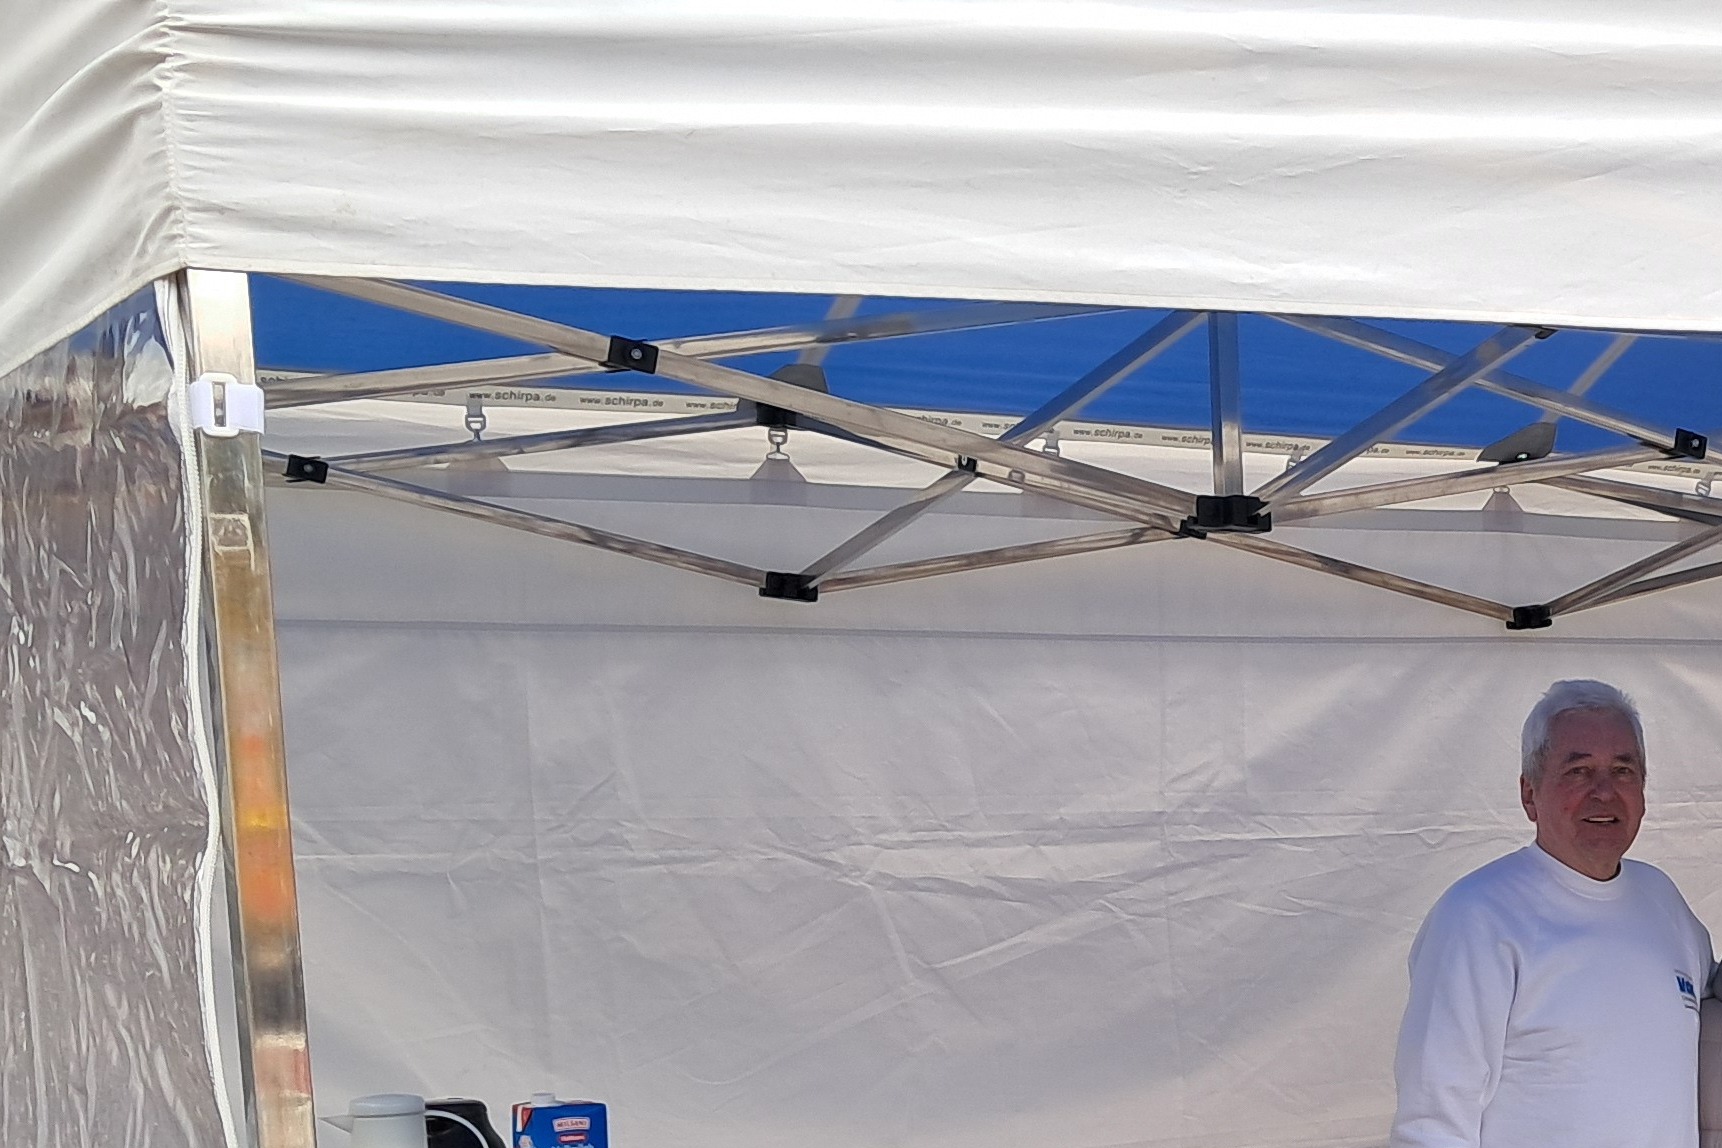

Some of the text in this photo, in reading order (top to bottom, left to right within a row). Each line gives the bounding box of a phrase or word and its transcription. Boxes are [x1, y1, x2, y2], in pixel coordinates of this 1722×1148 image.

[469, 391, 557, 402] www.schirpa.de
[579, 395, 664, 409] www.schirpa.de
[1073, 428, 1144, 440] www.schirpa.de
[1162, 433, 1213, 446] www.schirp
